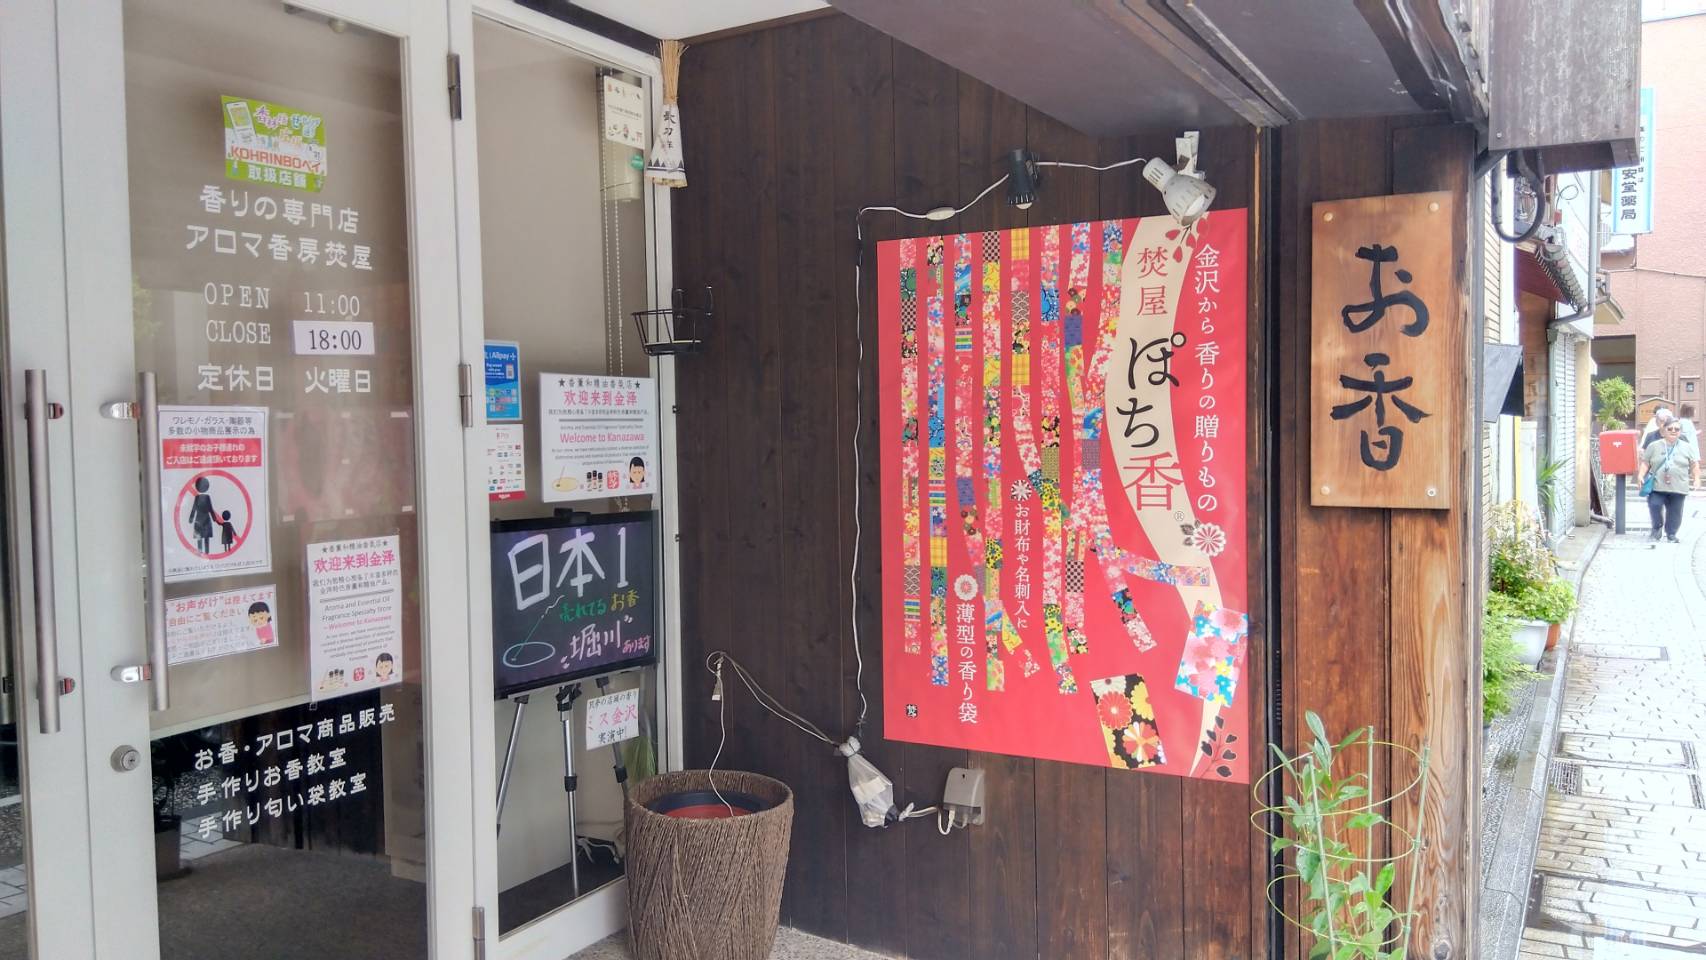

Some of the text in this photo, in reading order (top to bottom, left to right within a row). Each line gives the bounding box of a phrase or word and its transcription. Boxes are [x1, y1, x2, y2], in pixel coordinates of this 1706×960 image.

[200, 185, 359, 234] 香りの専門店
[186, 225, 373, 271] アロマ香房焚屋
[204, 282, 270, 309] OPEN
[303, 291, 360, 317] 11:00
[1136, 246, 1169, 317] 焚屋
[206, 320, 271, 344] CLOSE
[309, 329, 362, 351] 18:00
[198, 363, 274, 391] 定休日
[305, 366, 371, 394] 火曜日
[1194, 244, 1221, 512] 金沢から香りの贈りもの
[1329, 243, 1433, 472] お香
[560, 431, 645, 444] Welcome to Kanazawa
[1116, 331, 1188, 512] ぽち香
[1014, 503, 1031, 629] お財布や名刺入に
[622, 635, 652, 654] あります
[956, 603, 977, 724] 薄型の香り袋
[194, 703, 395, 771] お香・アロマ商品販売
[197, 747, 347, 805] 手作りお香教室
[198, 772, 367, 839] 手作り匂い袋教室
